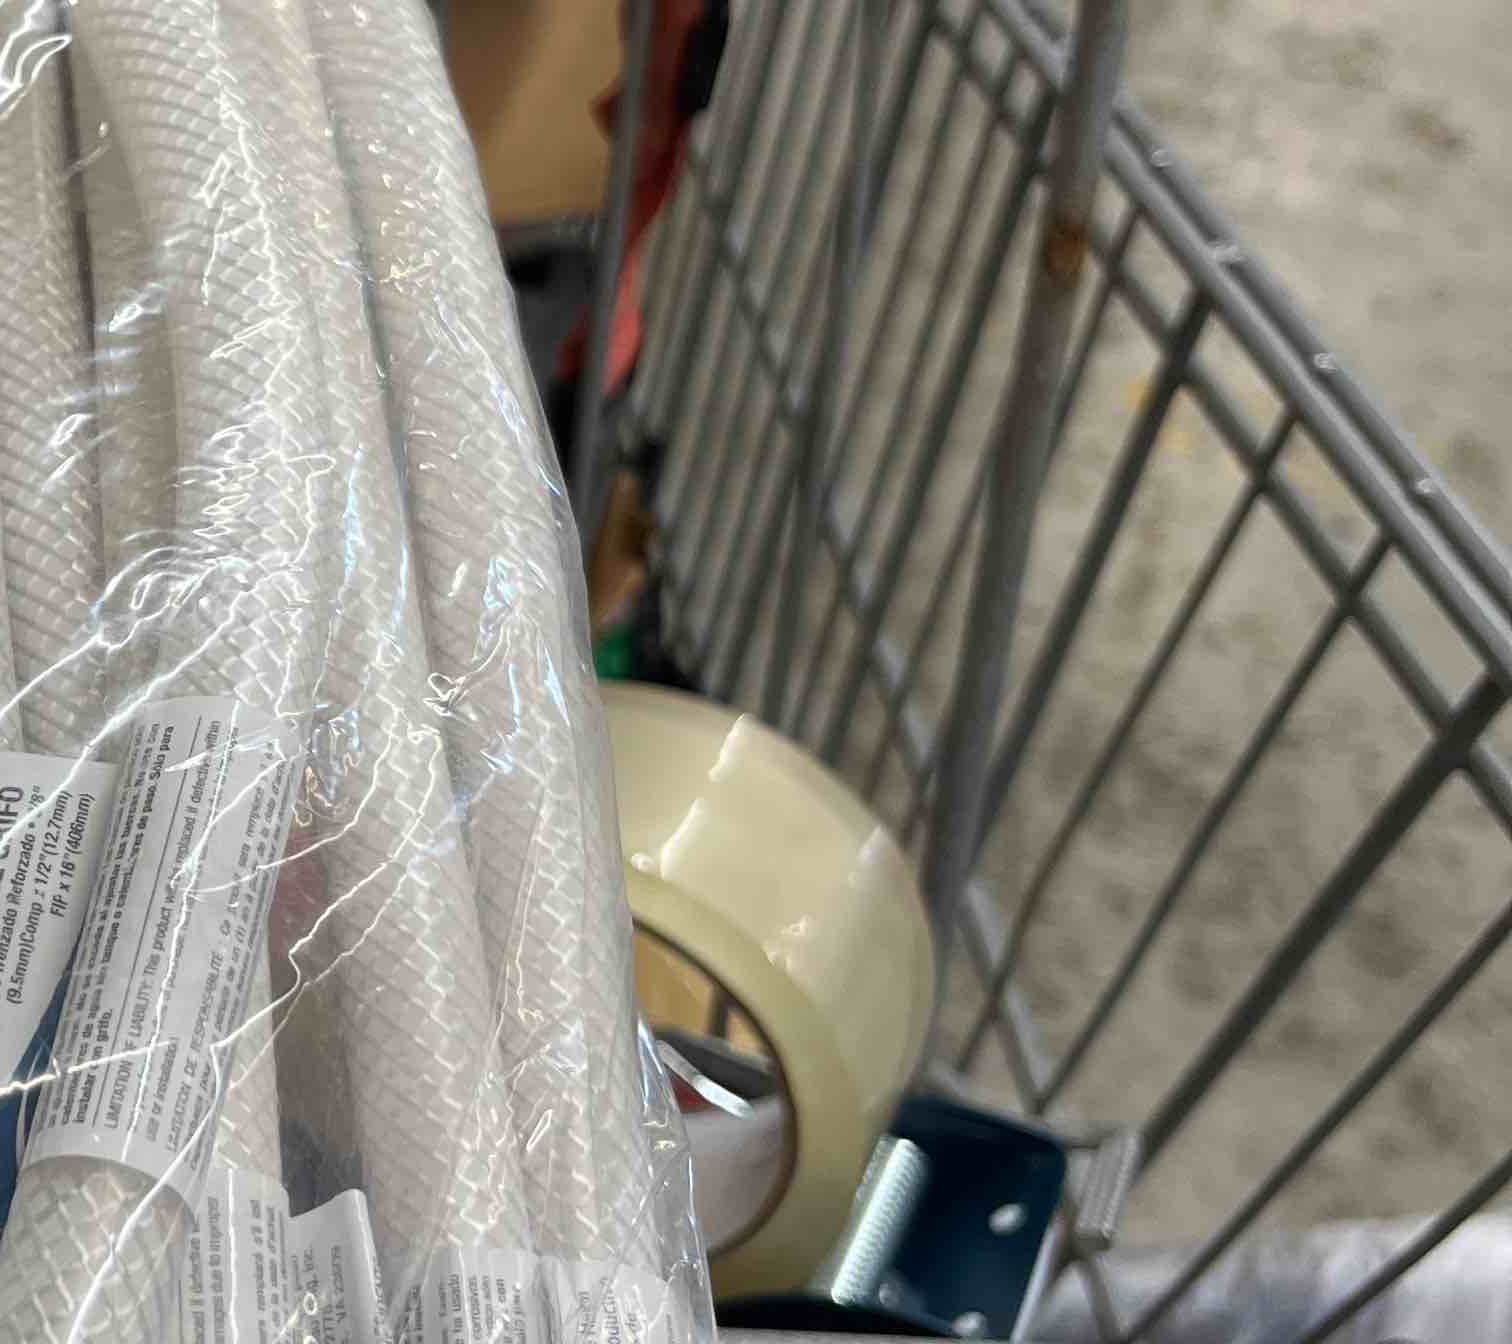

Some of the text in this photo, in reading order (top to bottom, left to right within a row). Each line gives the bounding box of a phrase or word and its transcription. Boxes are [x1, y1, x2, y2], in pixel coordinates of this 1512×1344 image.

[157, 725, 176, 751] para
[34, 790, 72, 885] 1/2"(12.7mm)
[49, 792, 96, 918] FIP x 16"(406mm)
[172, 816, 198, 864] replaced
[6, 833, 37, 904] Reforzado
[151, 906, 173, 951] product
[142, 951, 162, 976] This
[92, 1008, 113, 1043] grifo.
[103, 1060, 134, 1128] LIMITATION
